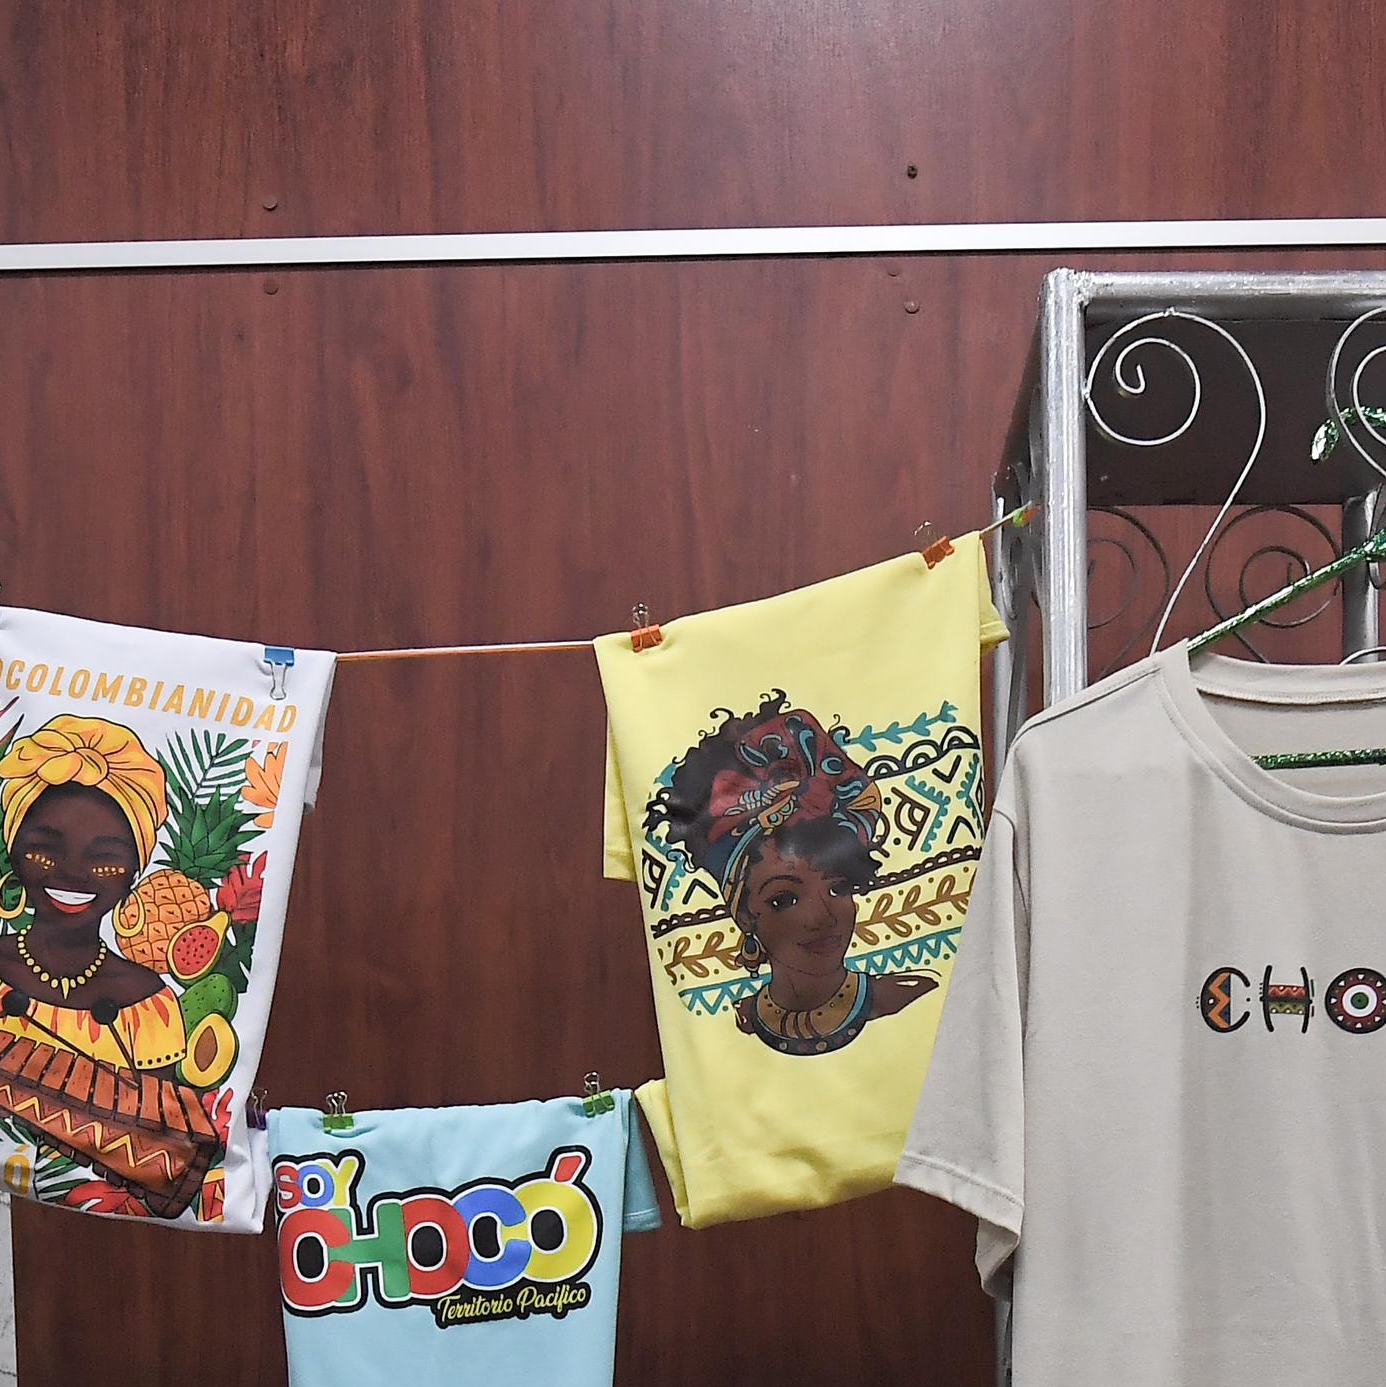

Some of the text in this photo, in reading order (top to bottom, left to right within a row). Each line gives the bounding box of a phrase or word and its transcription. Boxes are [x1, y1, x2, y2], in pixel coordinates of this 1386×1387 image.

[274, 1154, 359, 1212] SOY
[278, 1150, 598, 1311] CHOCÓ
[437, 1293, 513, 1323] Territorio
